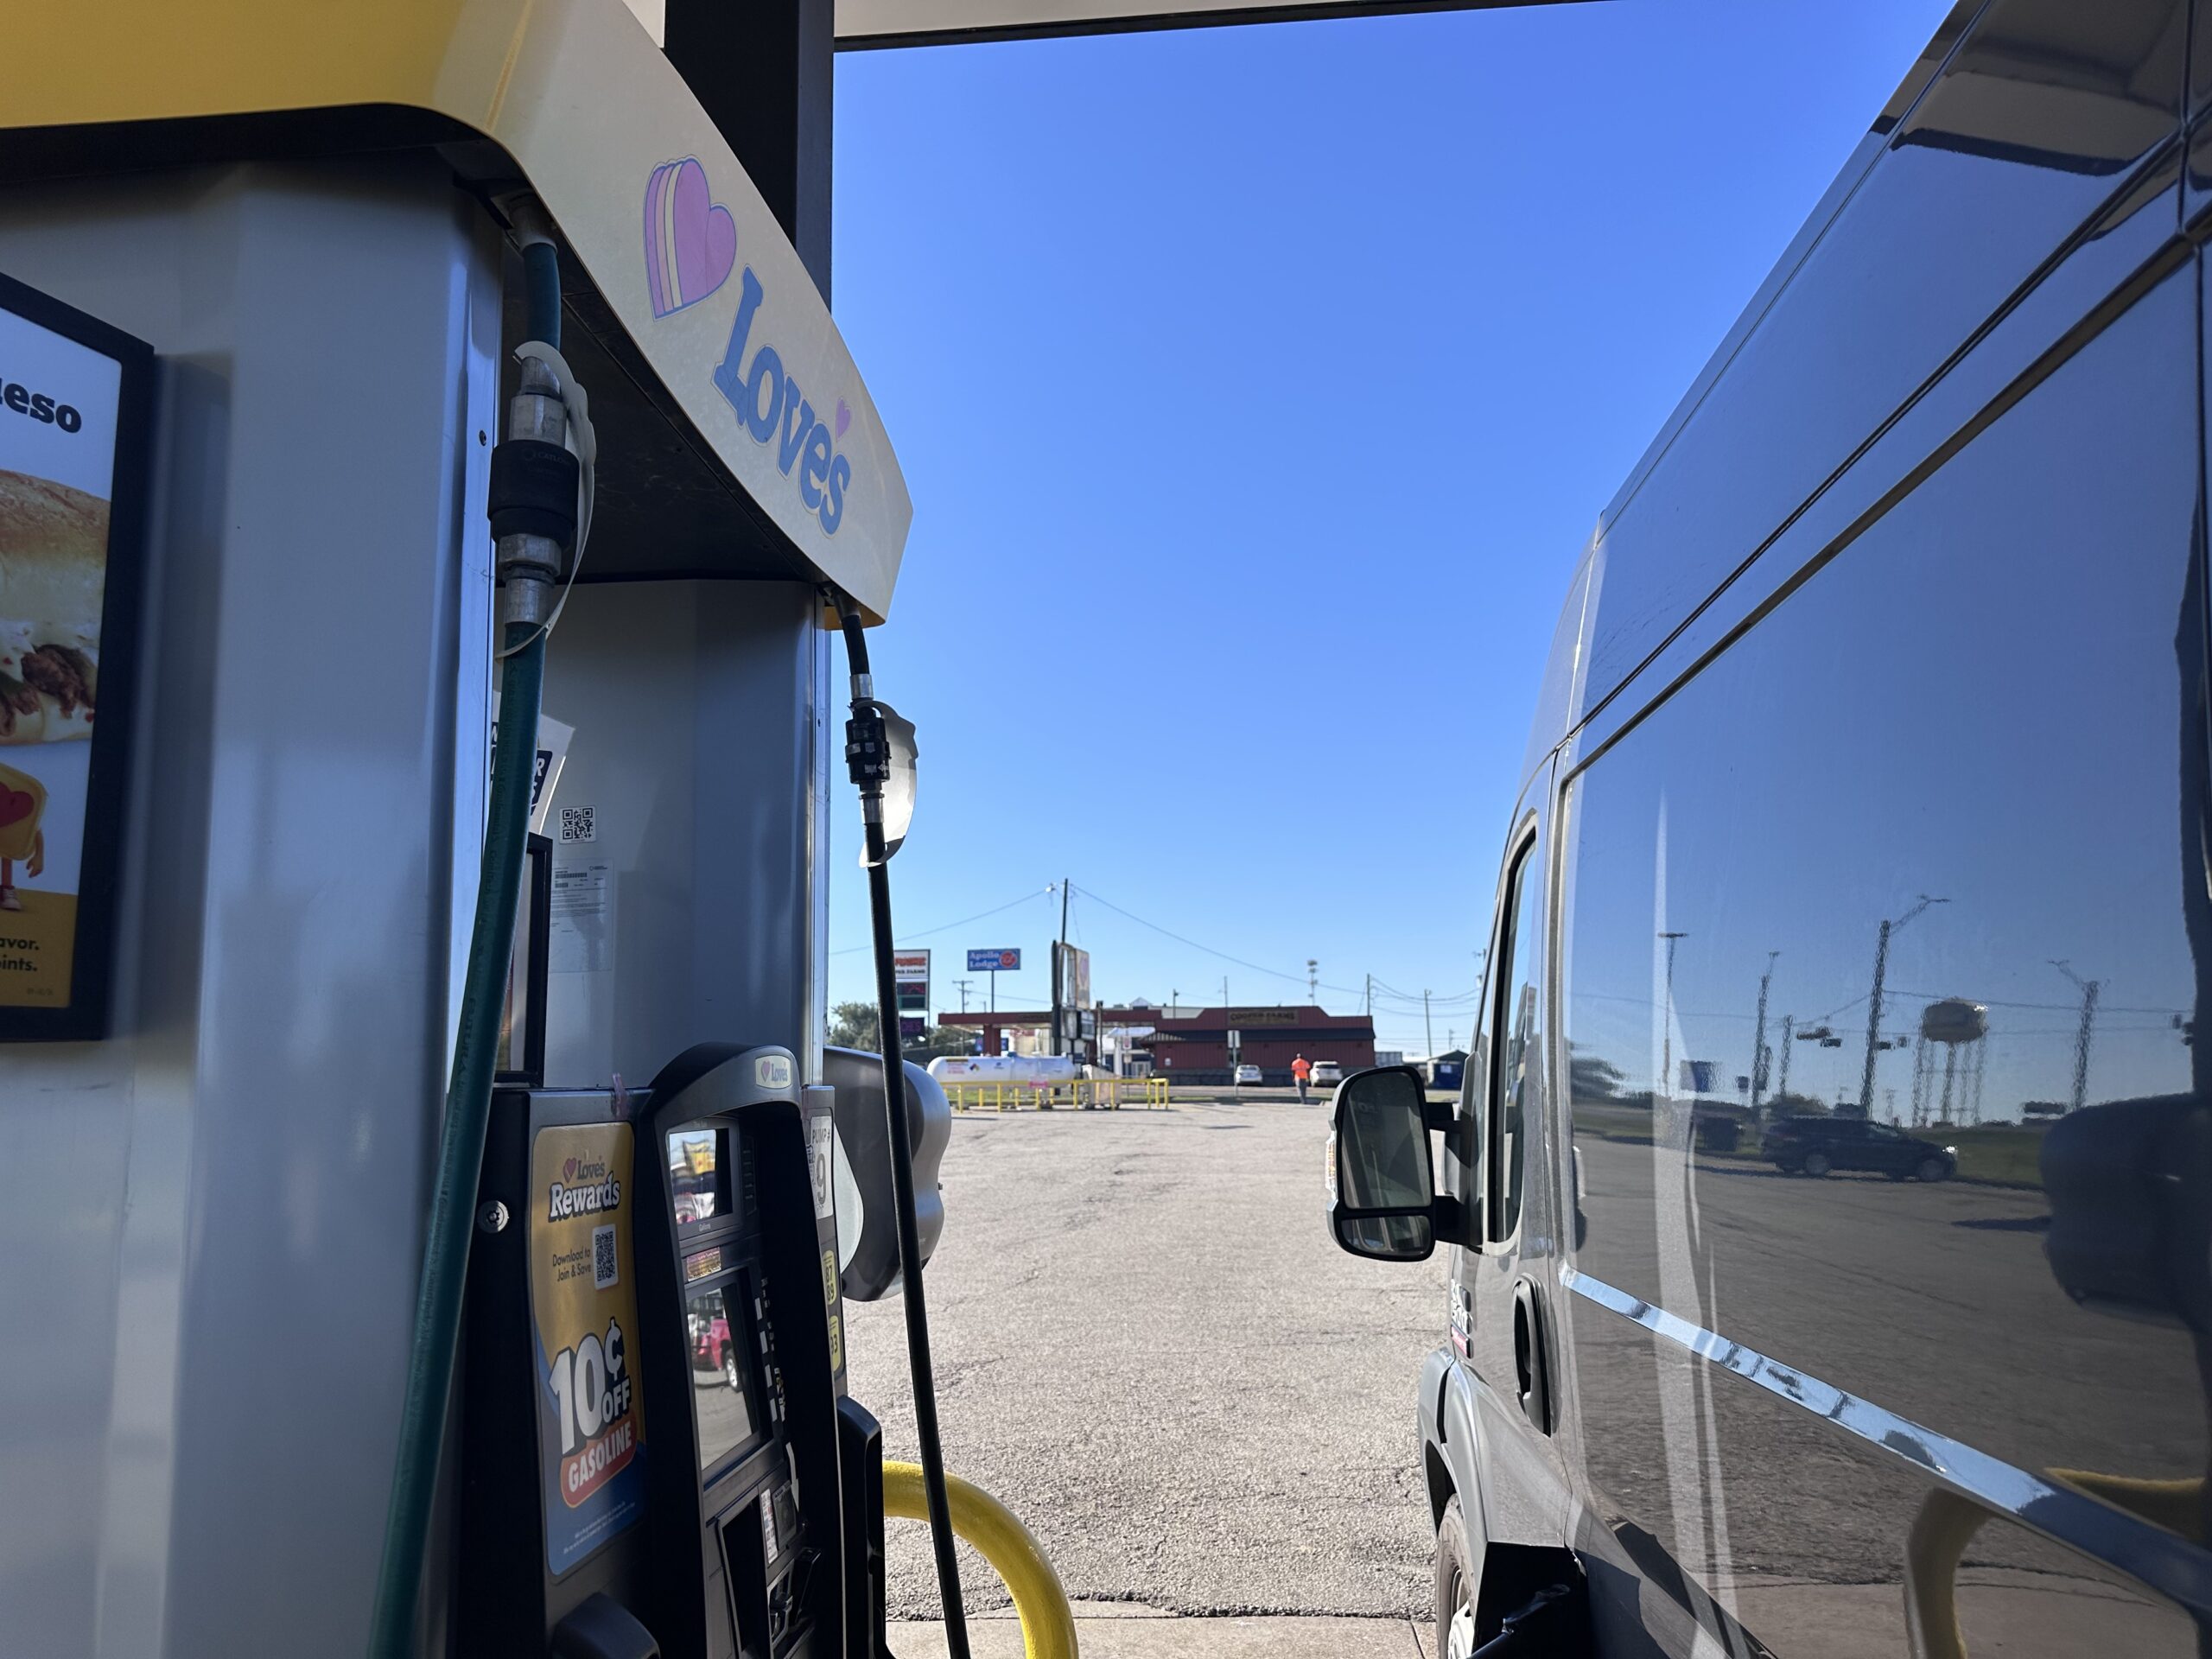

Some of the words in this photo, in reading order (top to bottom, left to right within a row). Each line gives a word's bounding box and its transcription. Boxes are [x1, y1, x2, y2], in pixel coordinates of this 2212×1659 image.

[0, 377, 82, 434] eso
[0, 954, 38, 972] ints.
[969, 950, 1000, 961] Apollo
[969, 960, 999, 969] Lodge
[577, 1155, 605, 1180] Love's
[817, 1153, 827, 1205] 9
[549, 1171, 620, 1223] Rewards
[552, 1246, 584, 1267] Download
[584, 1248, 591, 1258] to
[557, 1267, 570, 1282] Join
[571, 1266, 576, 1278] &
[577, 1263, 592, 1275] Save
[825, 1266, 833, 1283] 87
[601, 1376, 632, 1424] OFF
[568, 1421, 632, 1493] GASOLINE
